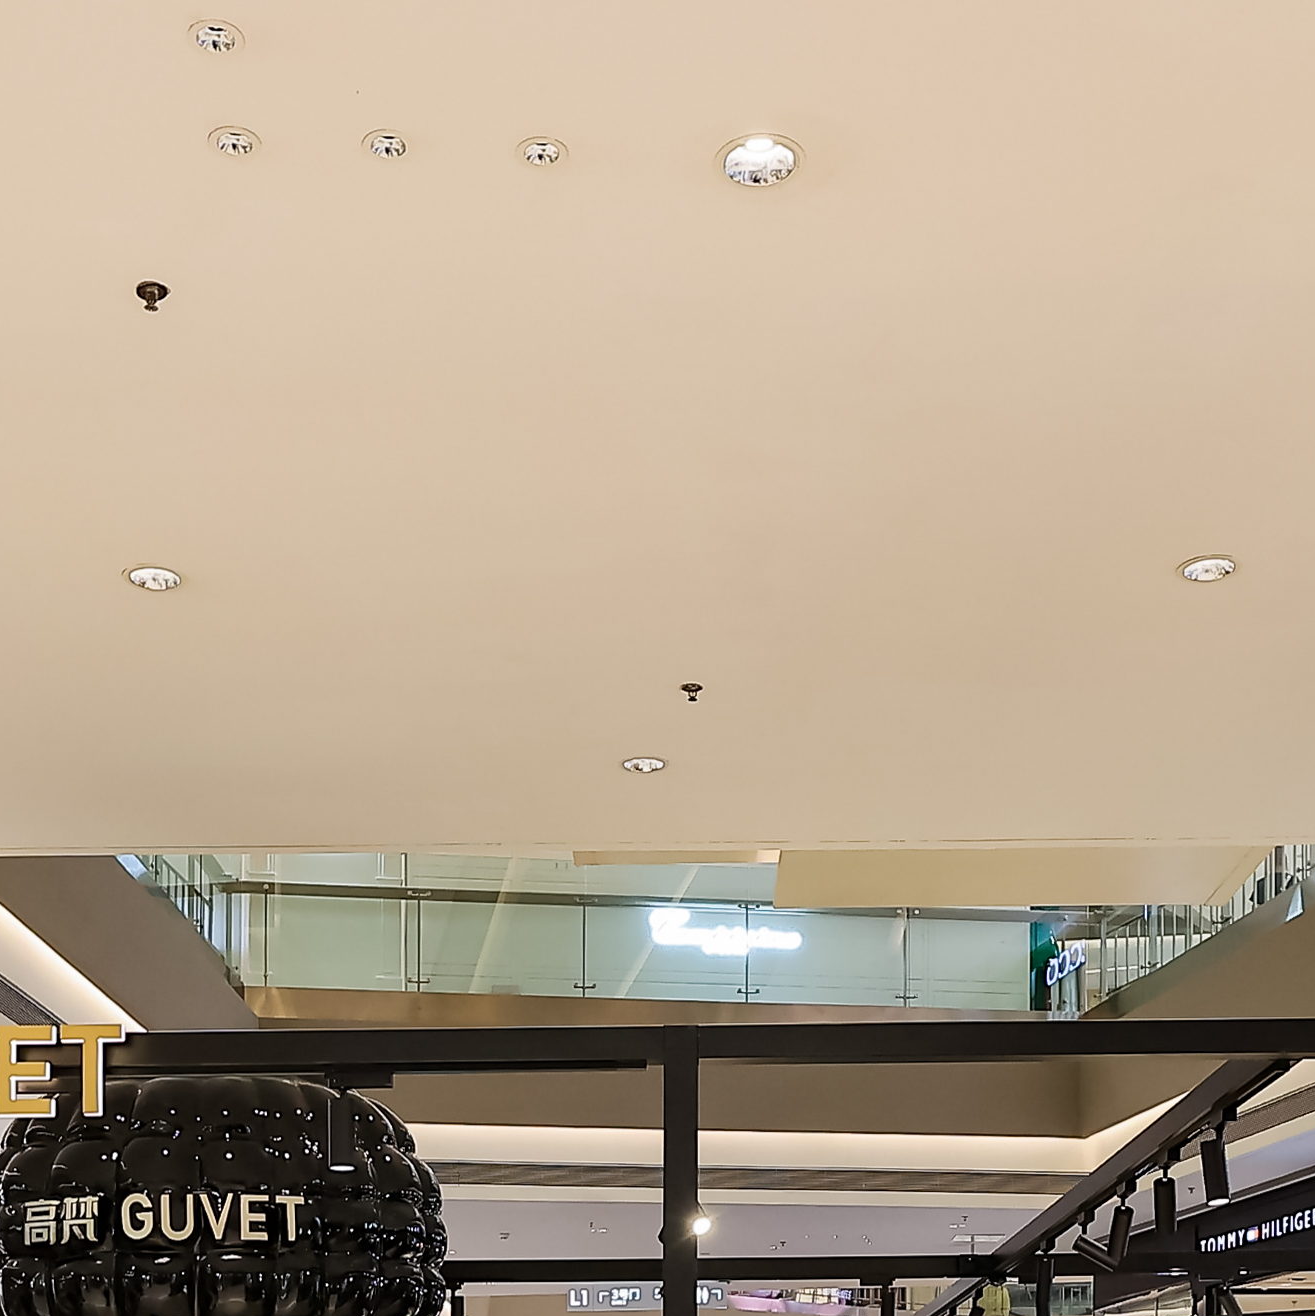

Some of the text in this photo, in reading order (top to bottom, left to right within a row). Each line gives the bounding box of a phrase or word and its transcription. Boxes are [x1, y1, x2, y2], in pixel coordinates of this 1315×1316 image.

[24, 1192, 305, 1246] 高梵 GUVET
[1200, 1229, 1245, 1252] TOMMY
[569, 1289, 588, 1306] L1
